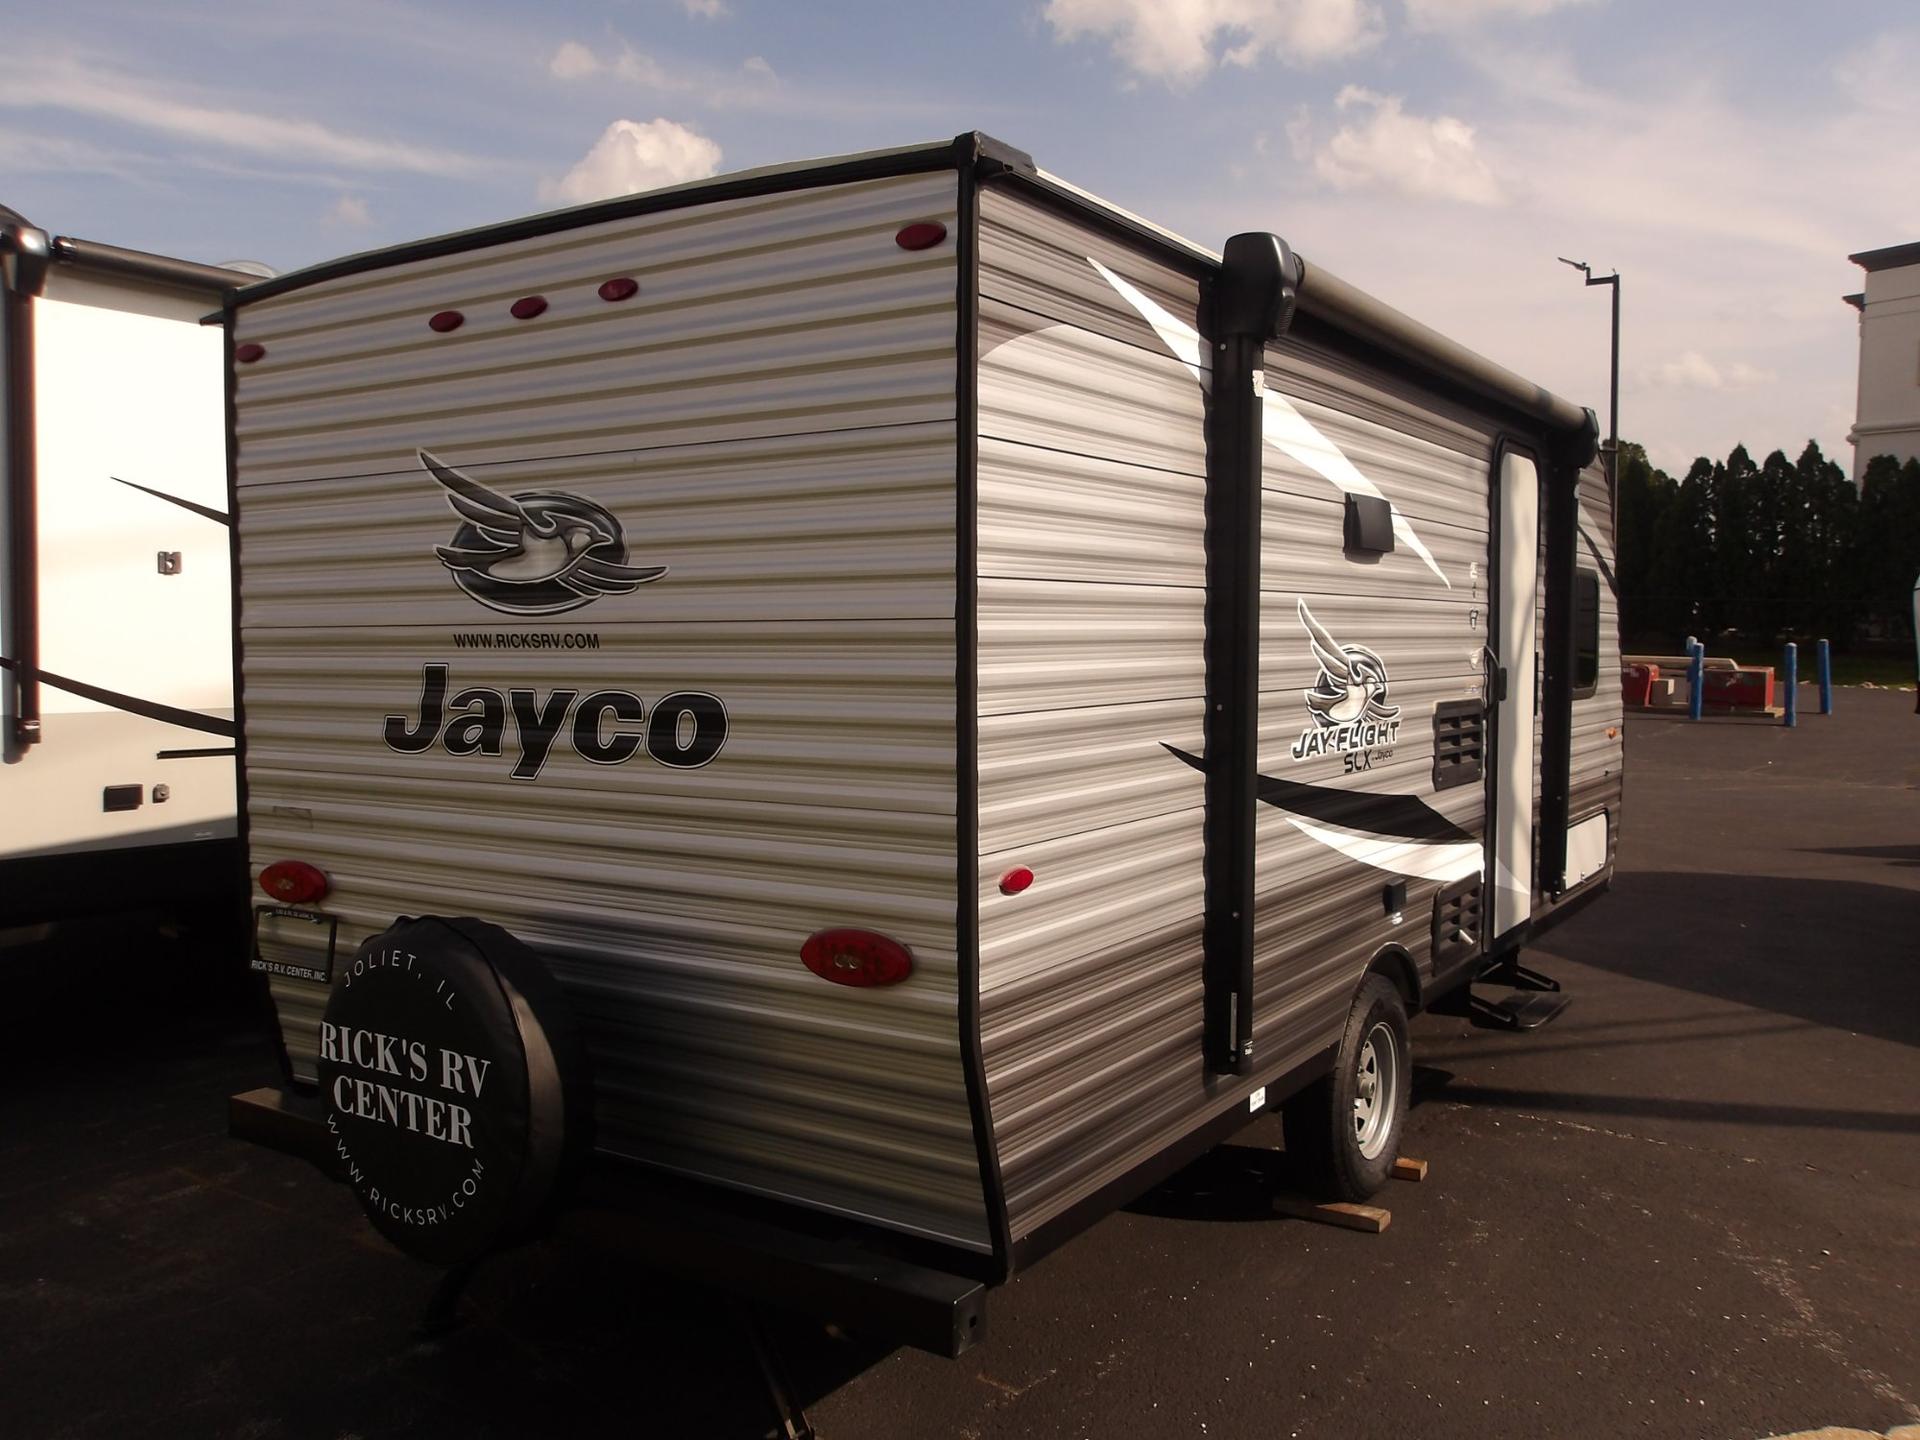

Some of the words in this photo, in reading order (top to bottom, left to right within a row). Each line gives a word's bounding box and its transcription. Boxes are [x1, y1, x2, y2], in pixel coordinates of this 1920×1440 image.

[453, 633, 600, 649] WWW.RICKSRV.COM
[383, 662, 730, 781] Jayco
[1291, 729, 1334, 761] JAY
[1336, 720, 1400, 752] FLIGHT
[1343, 750, 1373, 773] SLX
[251, 960, 274, 972] RICK'S
[274, 963, 286, 974] R.V.
[314, 971, 327, 981] INC.
[344, 950, 423, 988] JOLIET,
[436, 979, 455, 1010] IL
[319, 1020, 428, 1083] RICK'S
[439, 1048, 491, 1099] RV
[333, 1074, 474, 1149] CENTER
[327, 1113, 485, 1226] WWW.RICKSRV.COM
